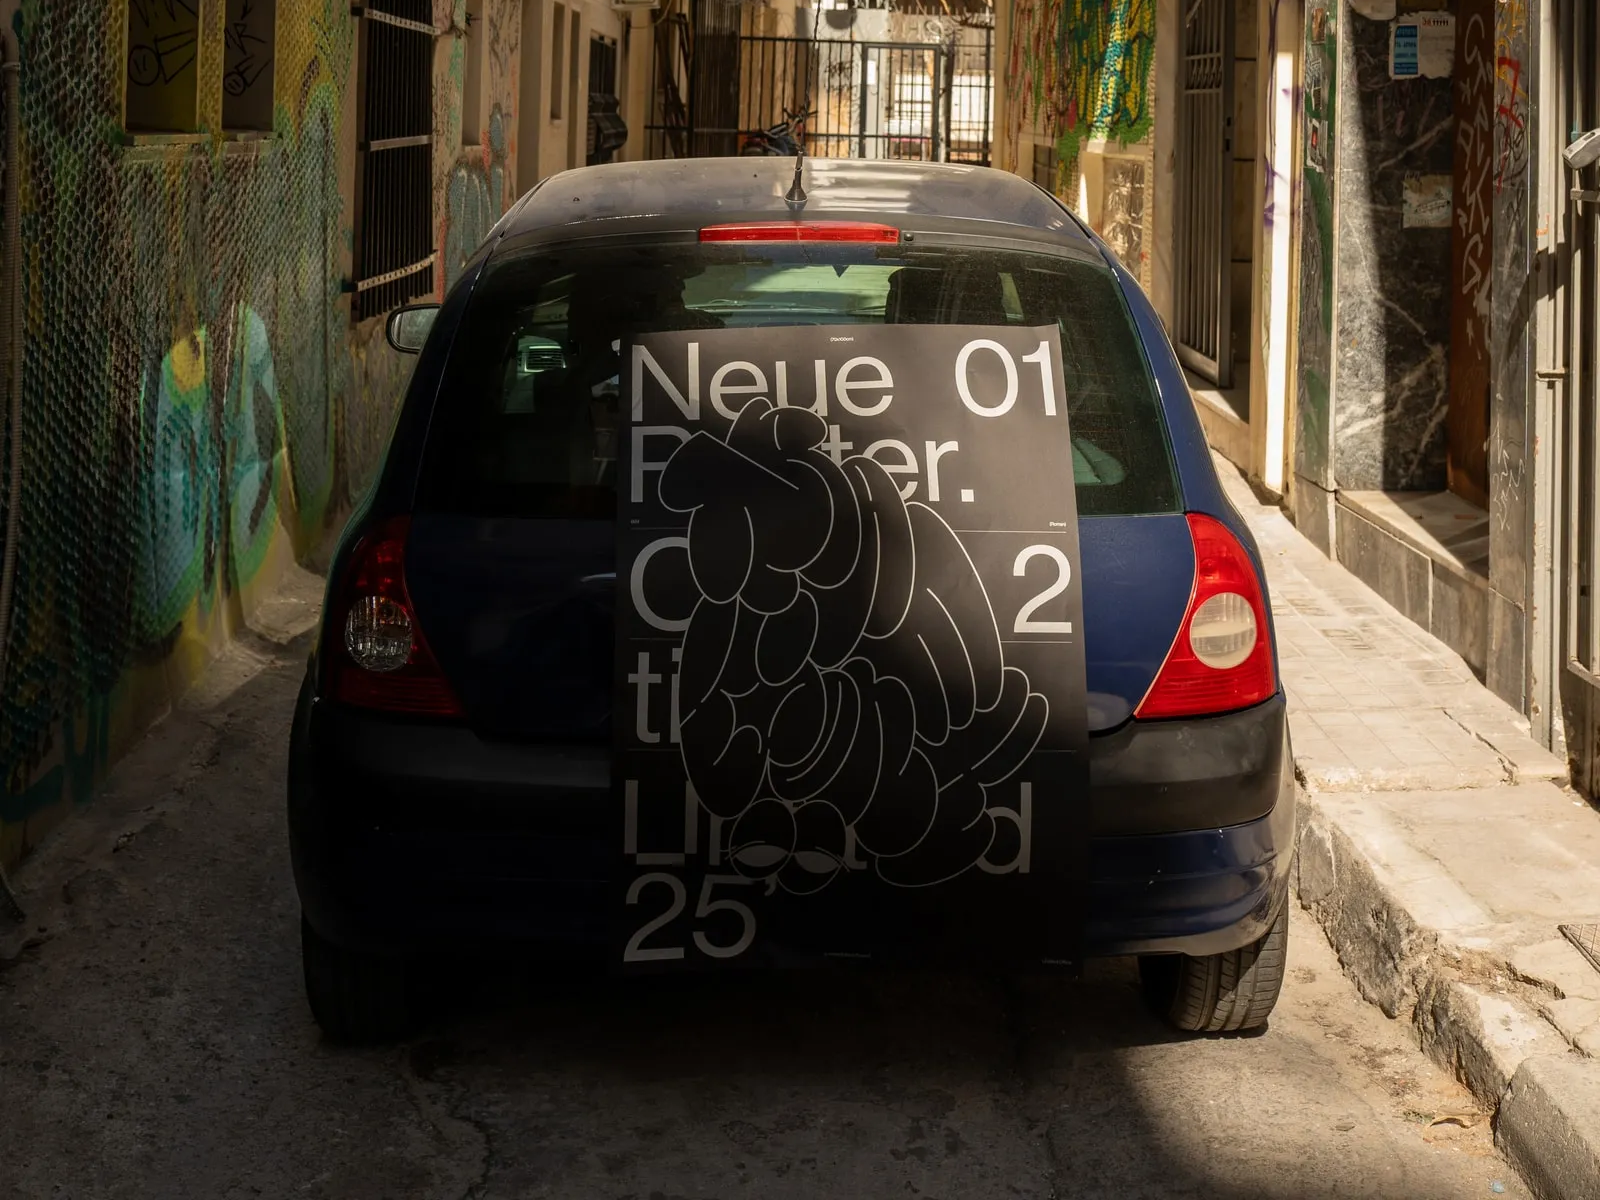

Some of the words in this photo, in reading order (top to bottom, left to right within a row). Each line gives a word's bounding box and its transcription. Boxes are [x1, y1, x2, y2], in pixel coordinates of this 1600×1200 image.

[631, 340, 894, 422] Neue
[955, 339, 1057, 417] 01
[1012, 545, 1072, 634] 2
